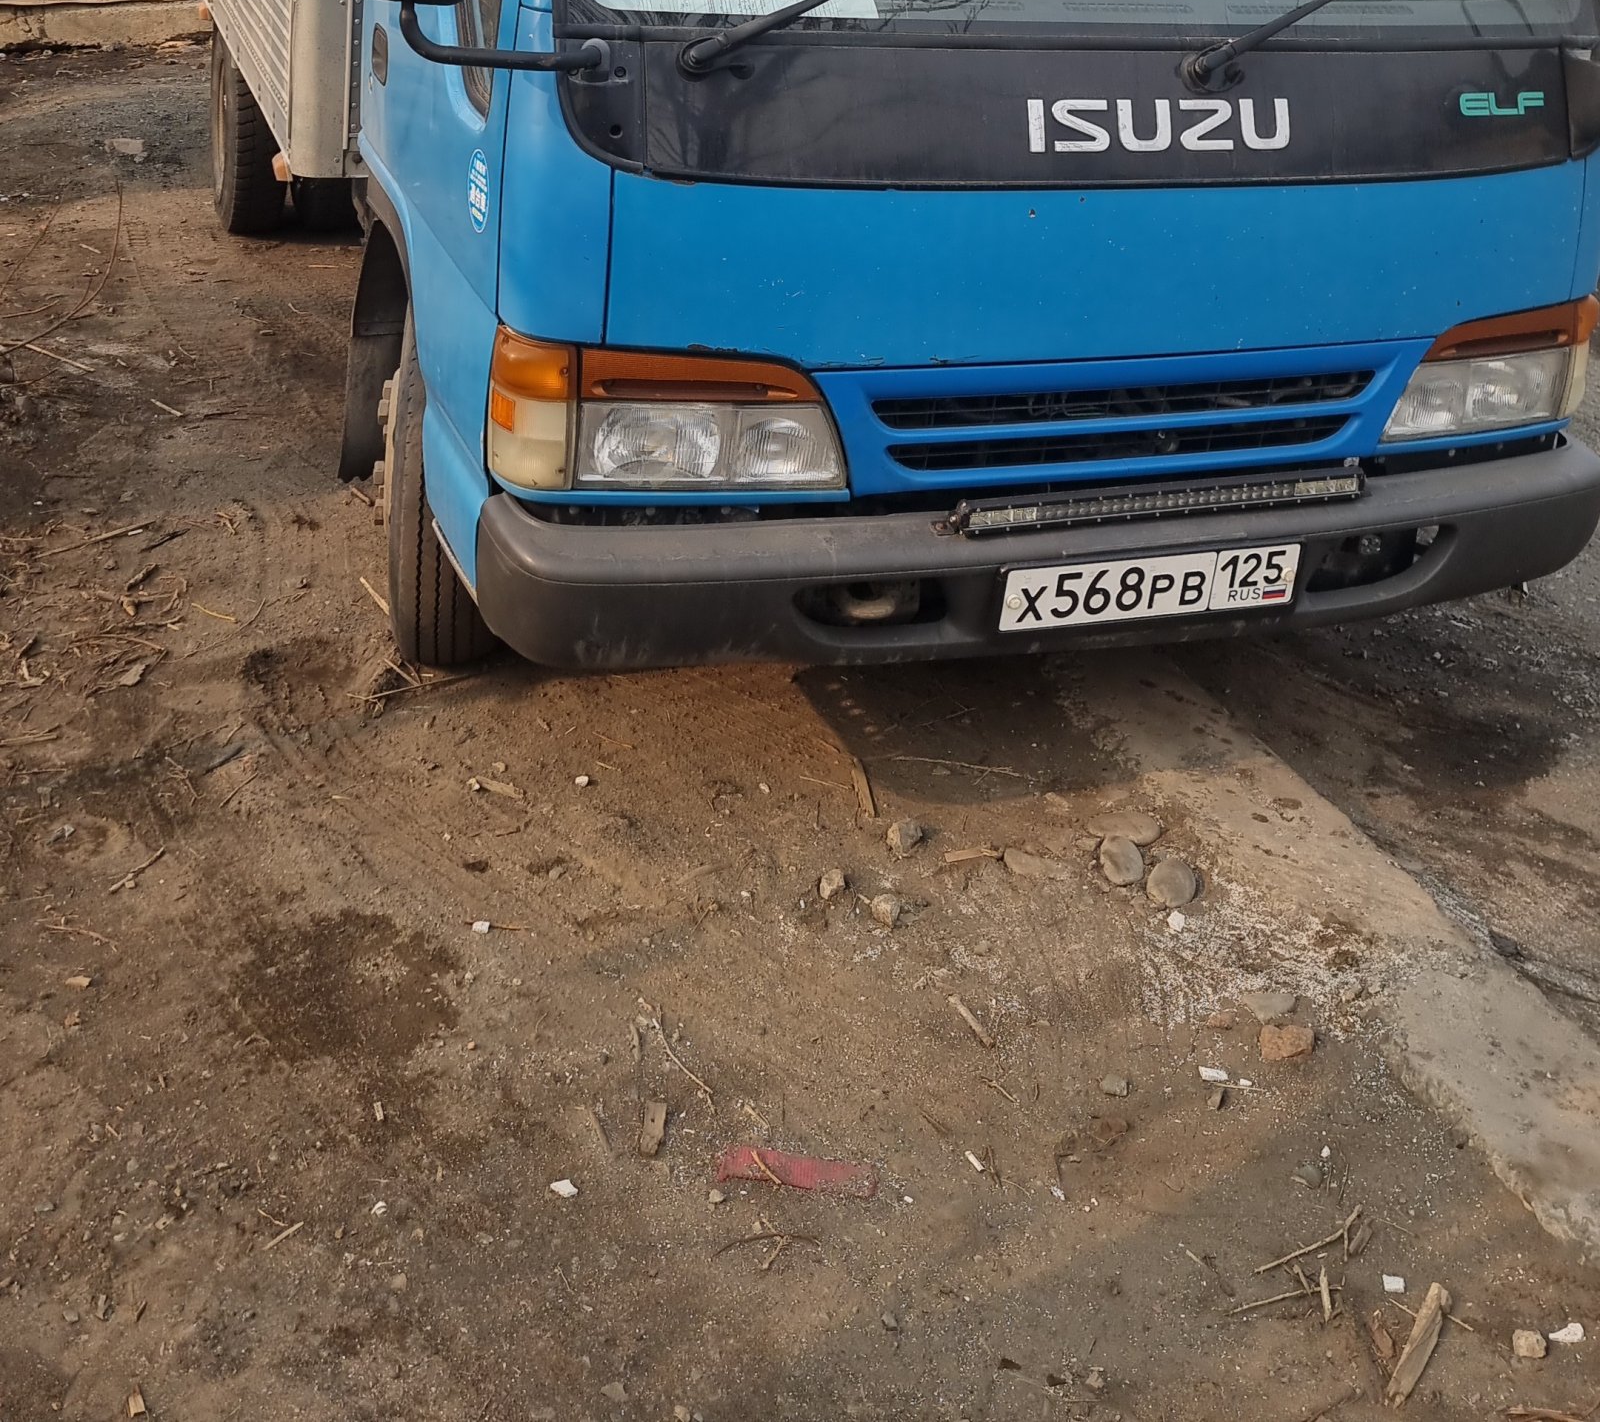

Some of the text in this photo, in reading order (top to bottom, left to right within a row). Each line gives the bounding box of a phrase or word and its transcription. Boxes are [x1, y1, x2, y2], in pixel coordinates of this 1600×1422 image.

[1459, 91, 1544, 116] ELF
[1027, 98, 1290, 153] ISUZU
[1220, 550, 1287, 589] 125
[1227, 587, 1261, 603] RUS
